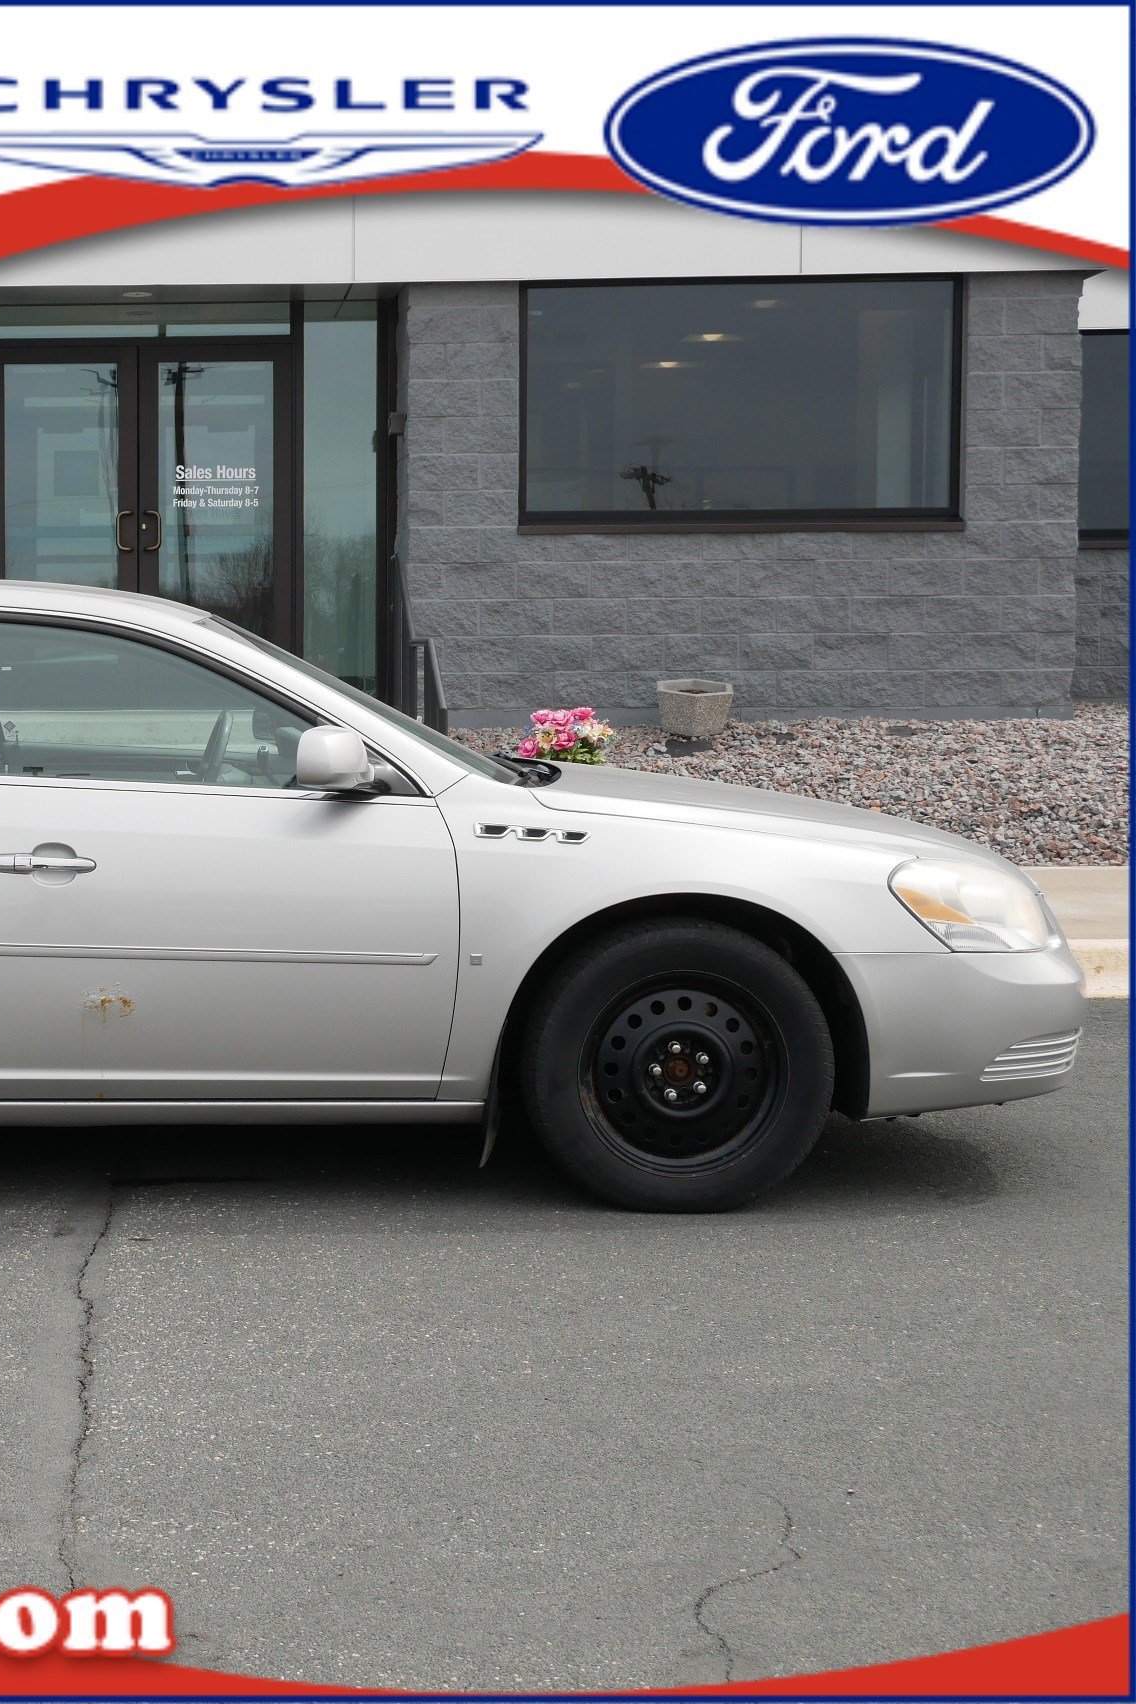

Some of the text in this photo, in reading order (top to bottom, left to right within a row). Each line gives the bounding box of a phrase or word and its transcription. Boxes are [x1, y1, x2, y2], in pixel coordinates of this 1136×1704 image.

[175, 464, 257, 480] Sales Hours
[173, 486, 260, 496] Monday-Thursday 8-7
[173, 499, 259, 509] Friday & Saturday 8-5
